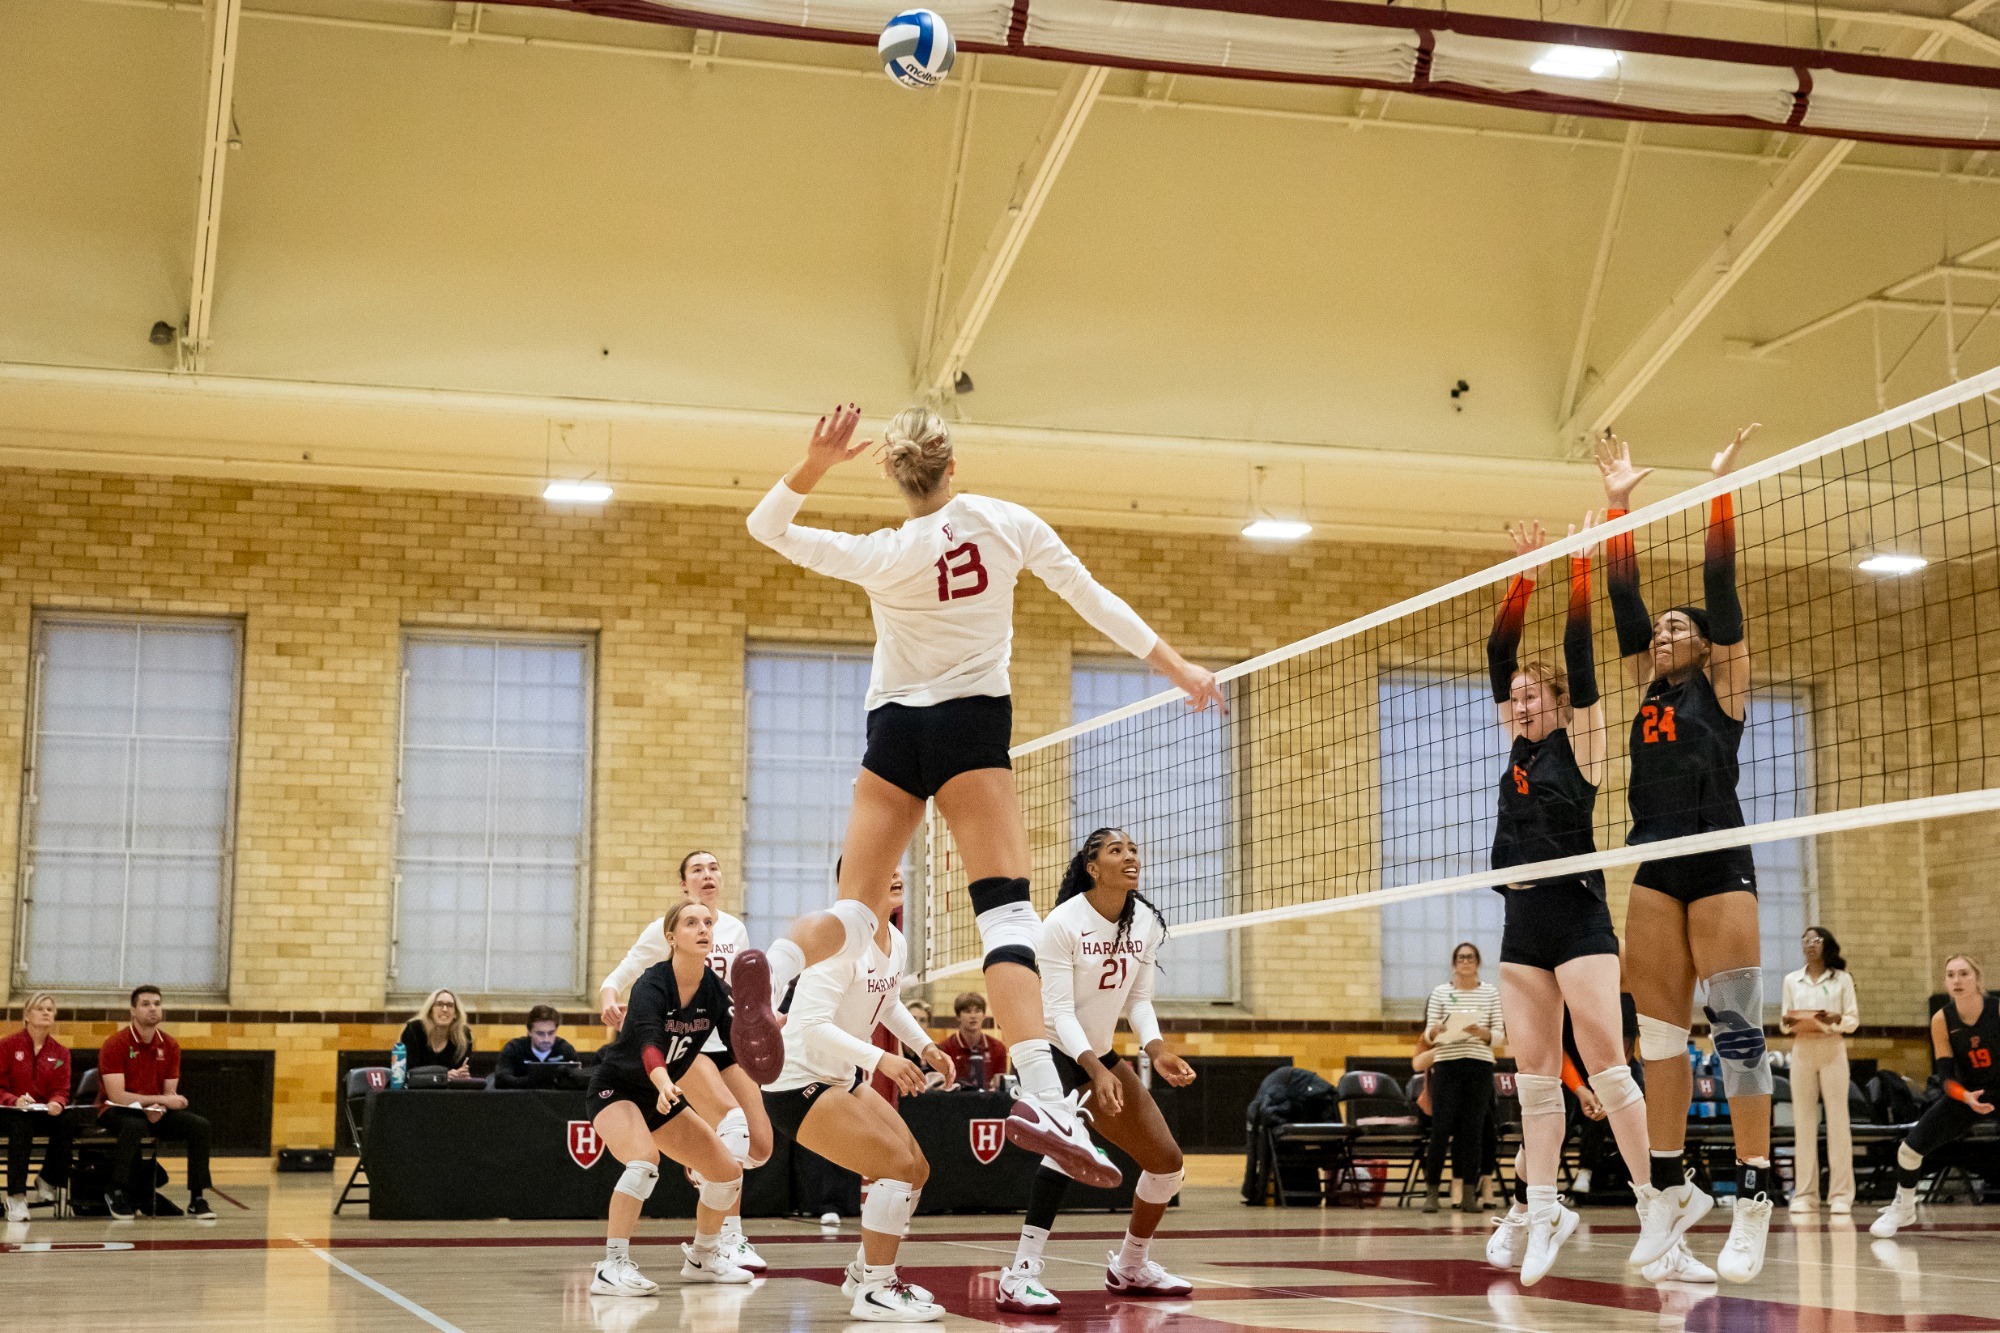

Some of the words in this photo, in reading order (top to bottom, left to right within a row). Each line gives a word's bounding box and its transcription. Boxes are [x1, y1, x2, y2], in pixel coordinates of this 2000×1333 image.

[934, 542, 988, 602] 13
[1641, 705, 1677, 743] 24
[1082, 940, 1143, 955] HARVARD
[1098, 957, 1127, 990] 21
[665, 1035, 693, 1065] 16
[1967, 1048, 1992, 1069] 19
[371, 1072, 382, 1087] H
[1362, 1075, 1374, 1089] H
[1500, 1075, 1512, 1090] H
[1700, 1080, 1712, 1093] H
[576, 1126, 596, 1154] H
[977, 1125, 997, 1151] H
